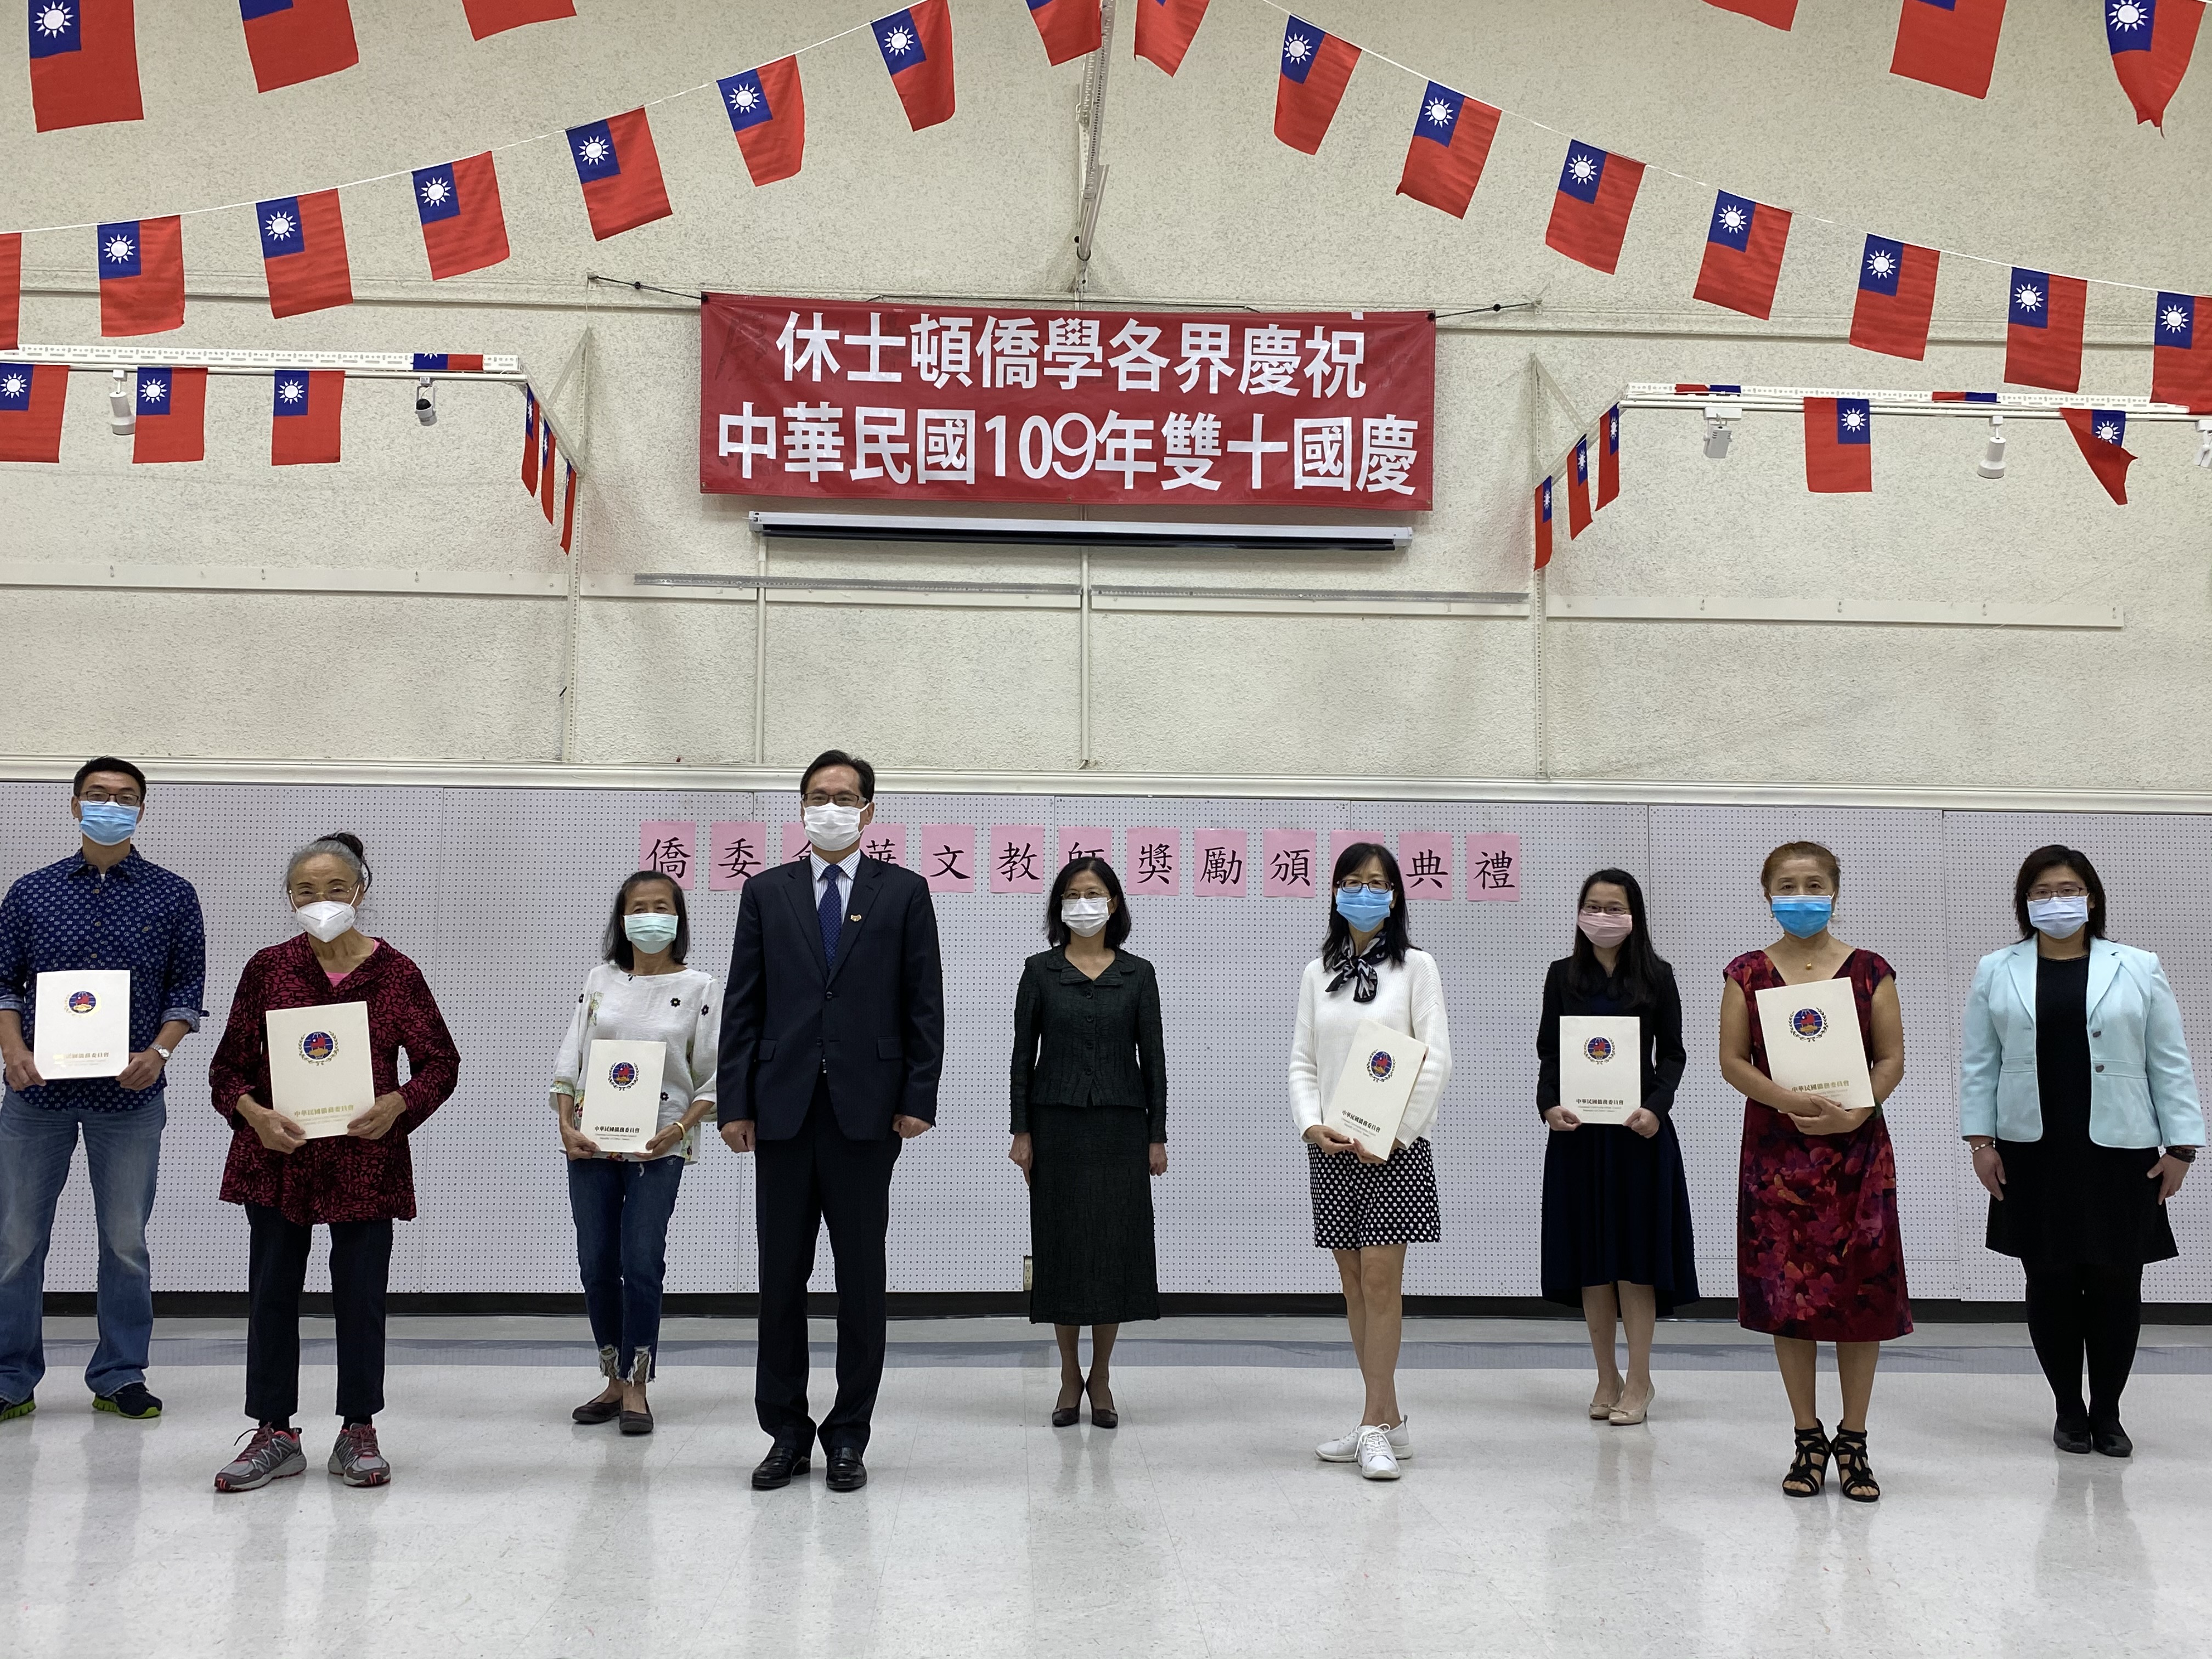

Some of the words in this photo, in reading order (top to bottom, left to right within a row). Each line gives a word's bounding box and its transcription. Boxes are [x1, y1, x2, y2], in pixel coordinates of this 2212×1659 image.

[776, 311, 1367, 398] 休士頓僑學各界慶祝
[718, 401, 1418, 495] 中華民國109年雙十國慶
[645, 837, 1515, 890] 僑委華文教獎勵頒典禮
